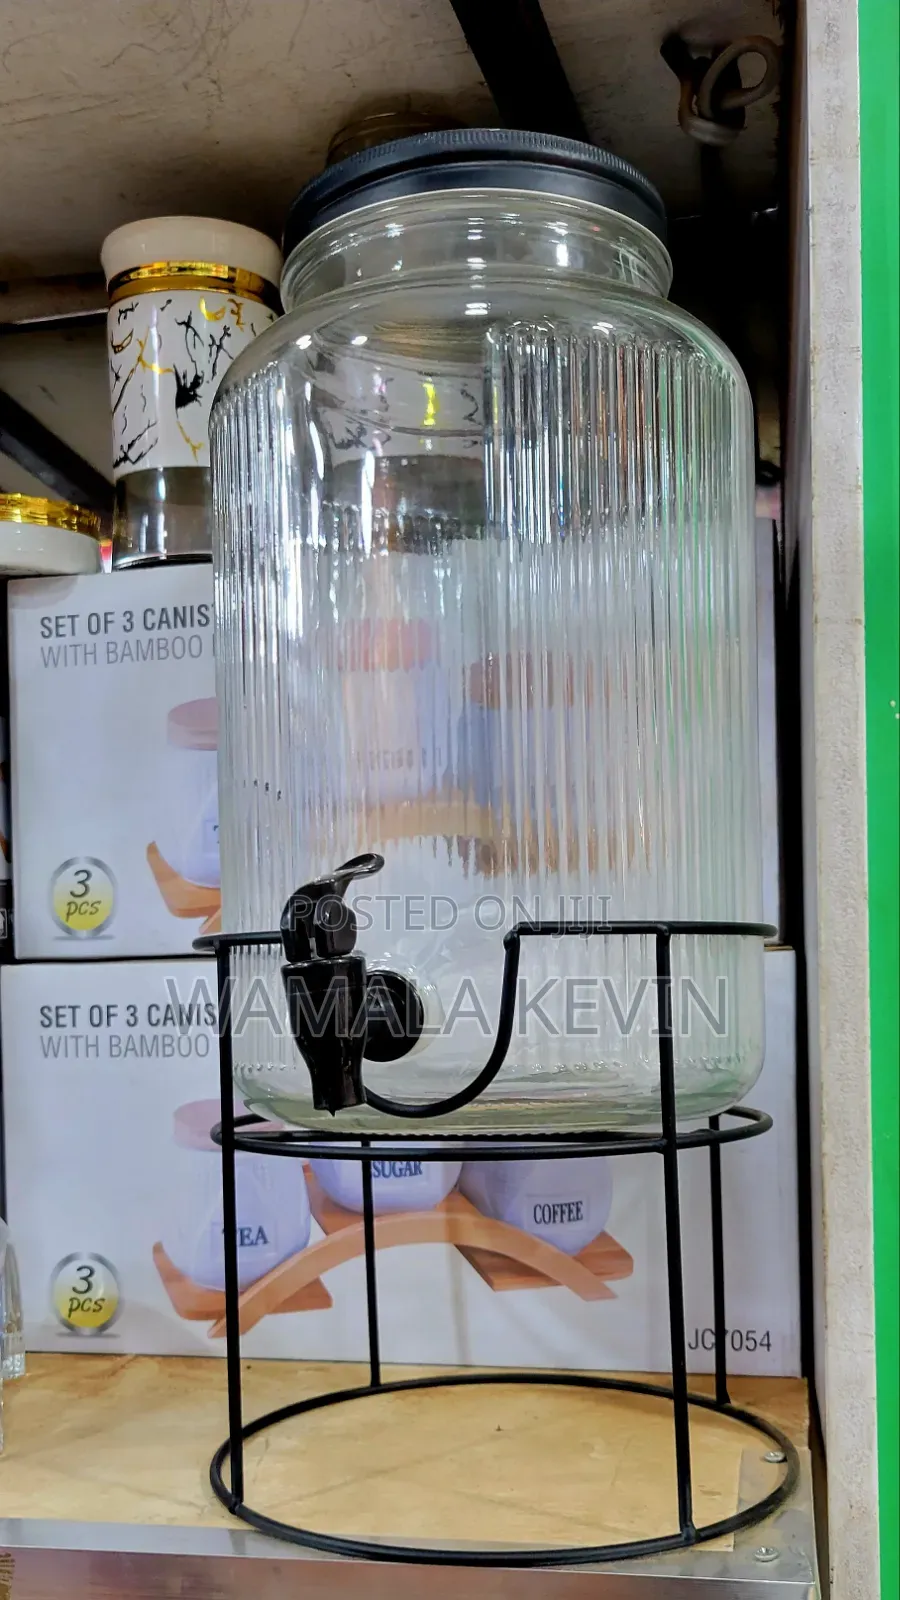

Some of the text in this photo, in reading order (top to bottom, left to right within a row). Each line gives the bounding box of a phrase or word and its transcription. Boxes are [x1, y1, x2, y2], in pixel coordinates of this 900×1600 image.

[40, 604, 214, 639] SET OF 3 CANIS
[40, 634, 203, 669] WITH BAMBOO
[69, 869, 93, 898] 3
[66, 900, 101, 922] pcs
[40, 1005, 80, 1028] SET
[89, 1004, 118, 1028] OF
[126, 1004, 139, 1027] 3
[40, 1033, 210, 1059] WITH BAMBOO
[533, 1200, 583, 1225] COFFEE
[222, 1225, 270, 1247] EA
[72, 1266, 96, 1295] 3
[68, 1296, 105, 1318] pcs
[688, 1328, 772, 1352] JC054
